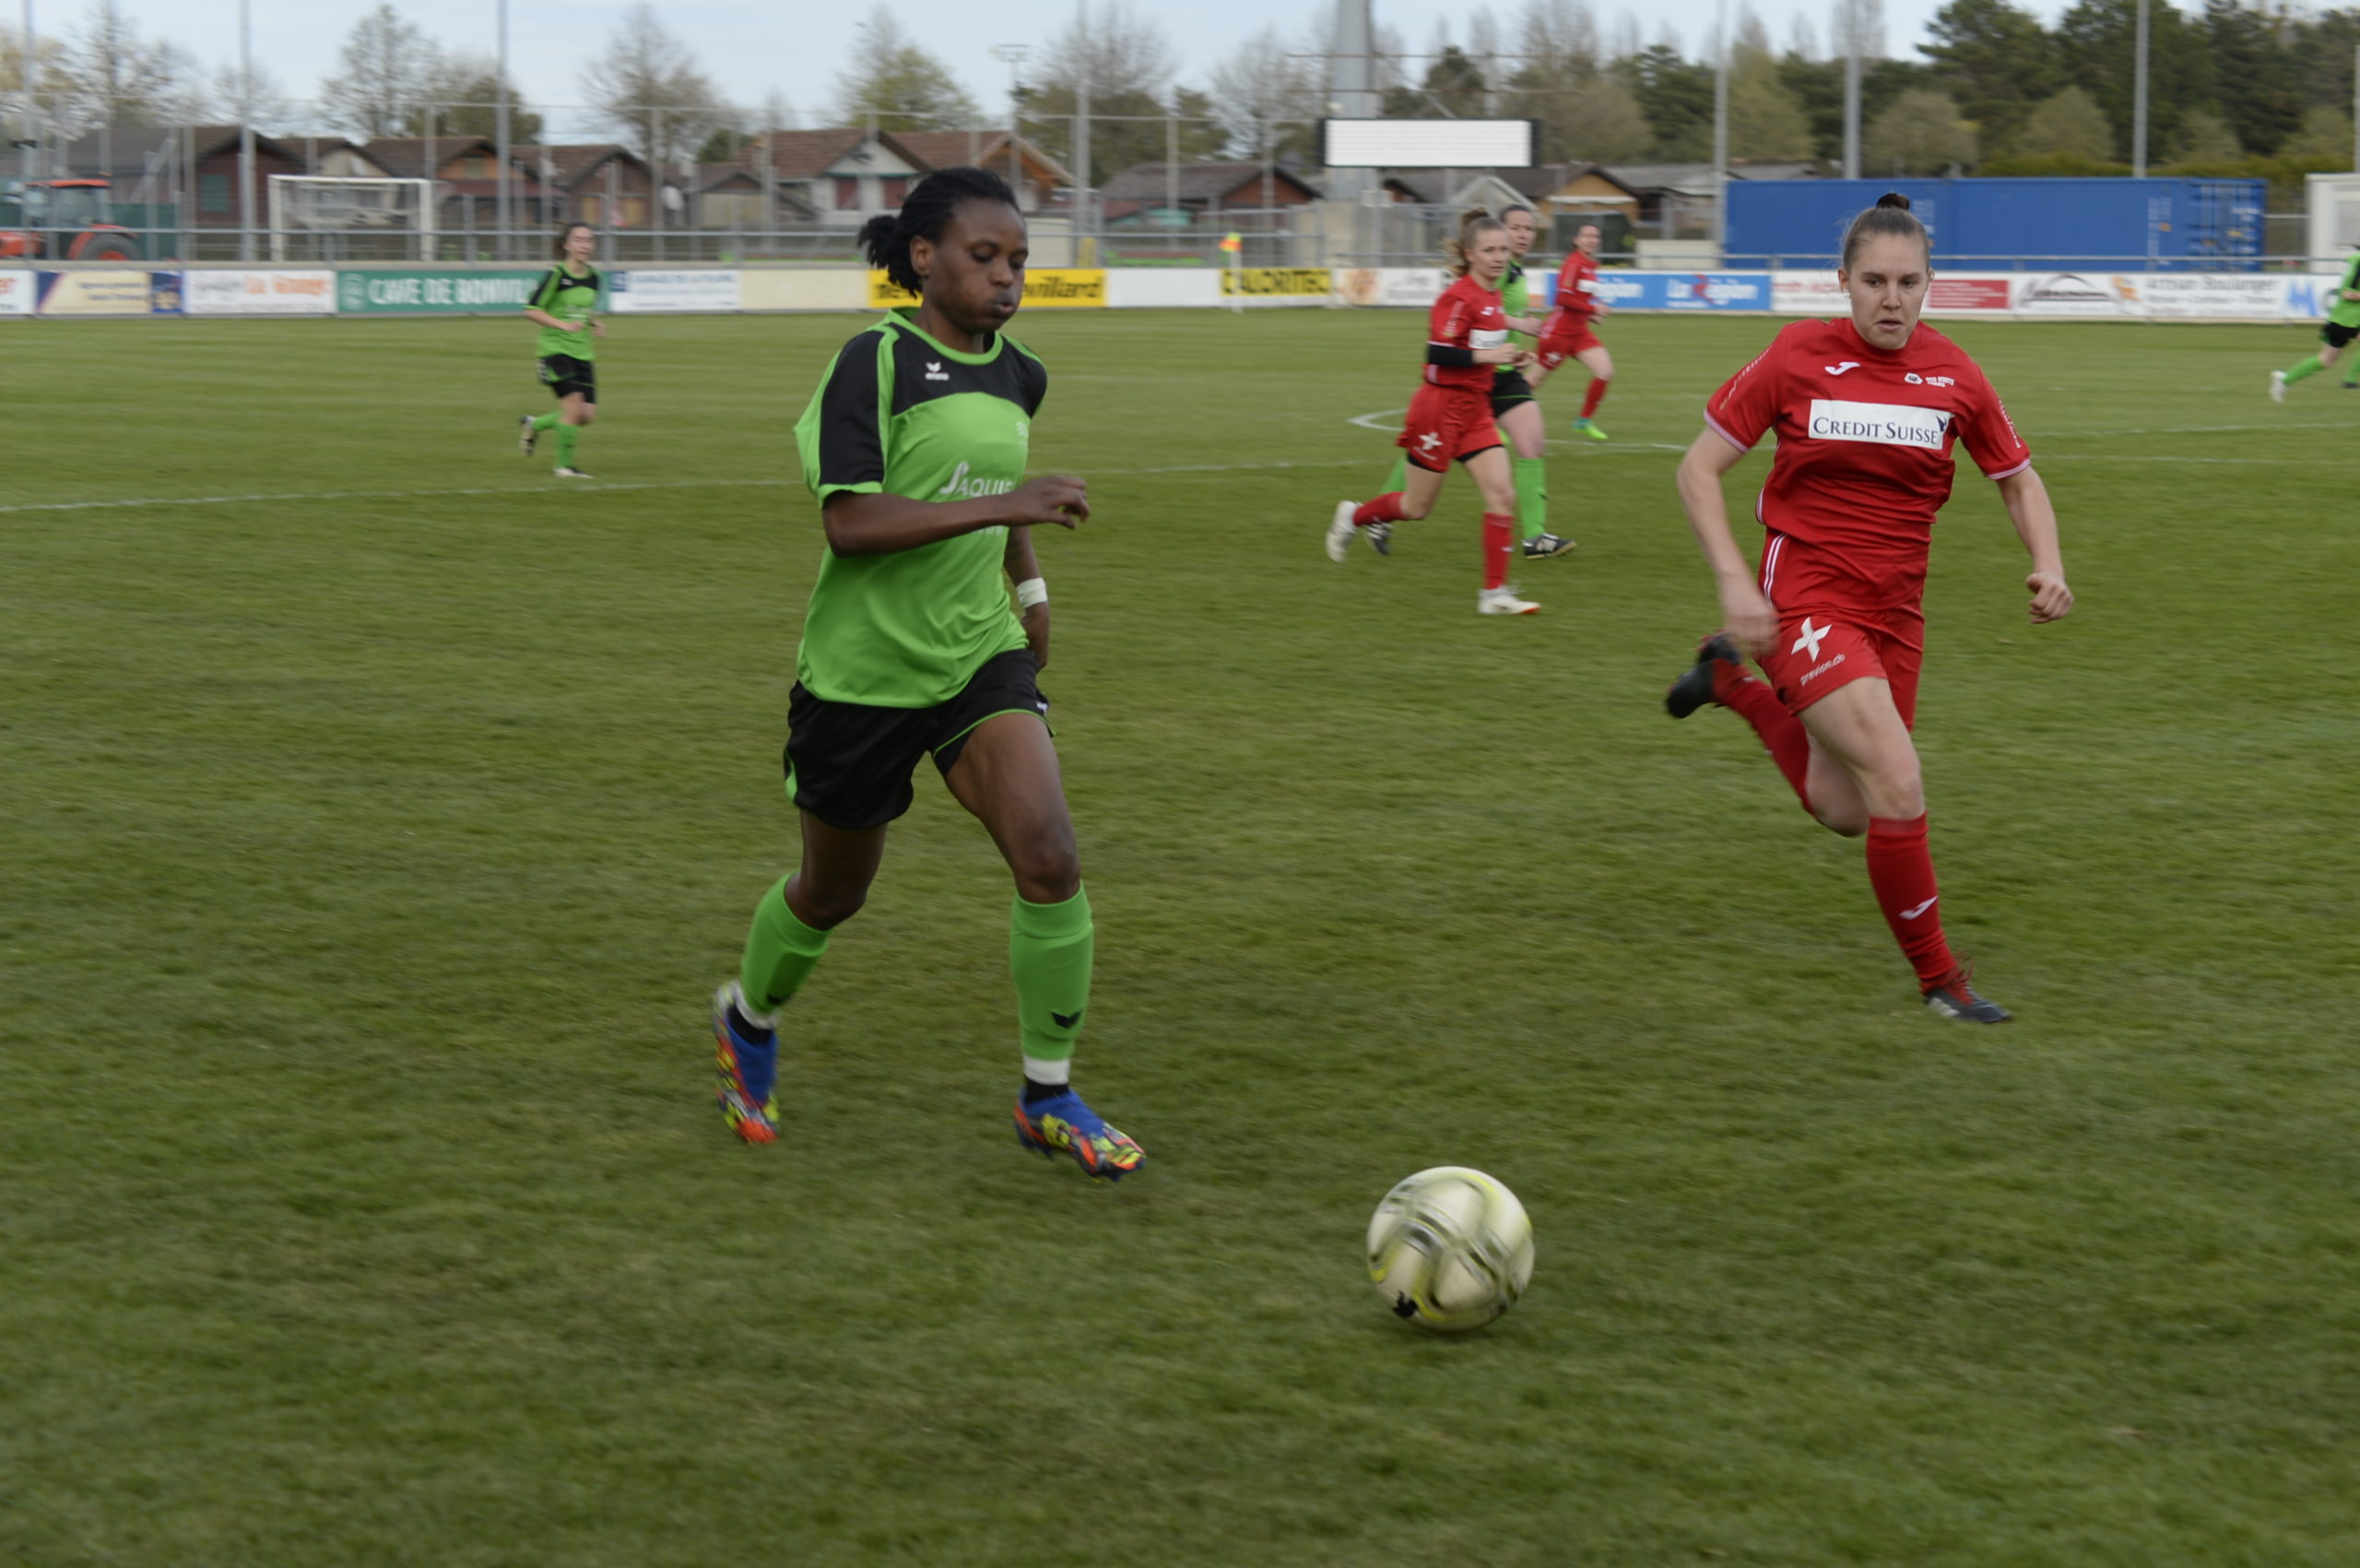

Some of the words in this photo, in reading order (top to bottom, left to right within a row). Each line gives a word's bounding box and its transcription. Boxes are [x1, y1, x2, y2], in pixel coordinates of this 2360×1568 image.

[423, 278, 454, 304] DE
[1812, 417, 1882, 438] CREDIT
[1885, 421, 1938, 444] SUISSE
